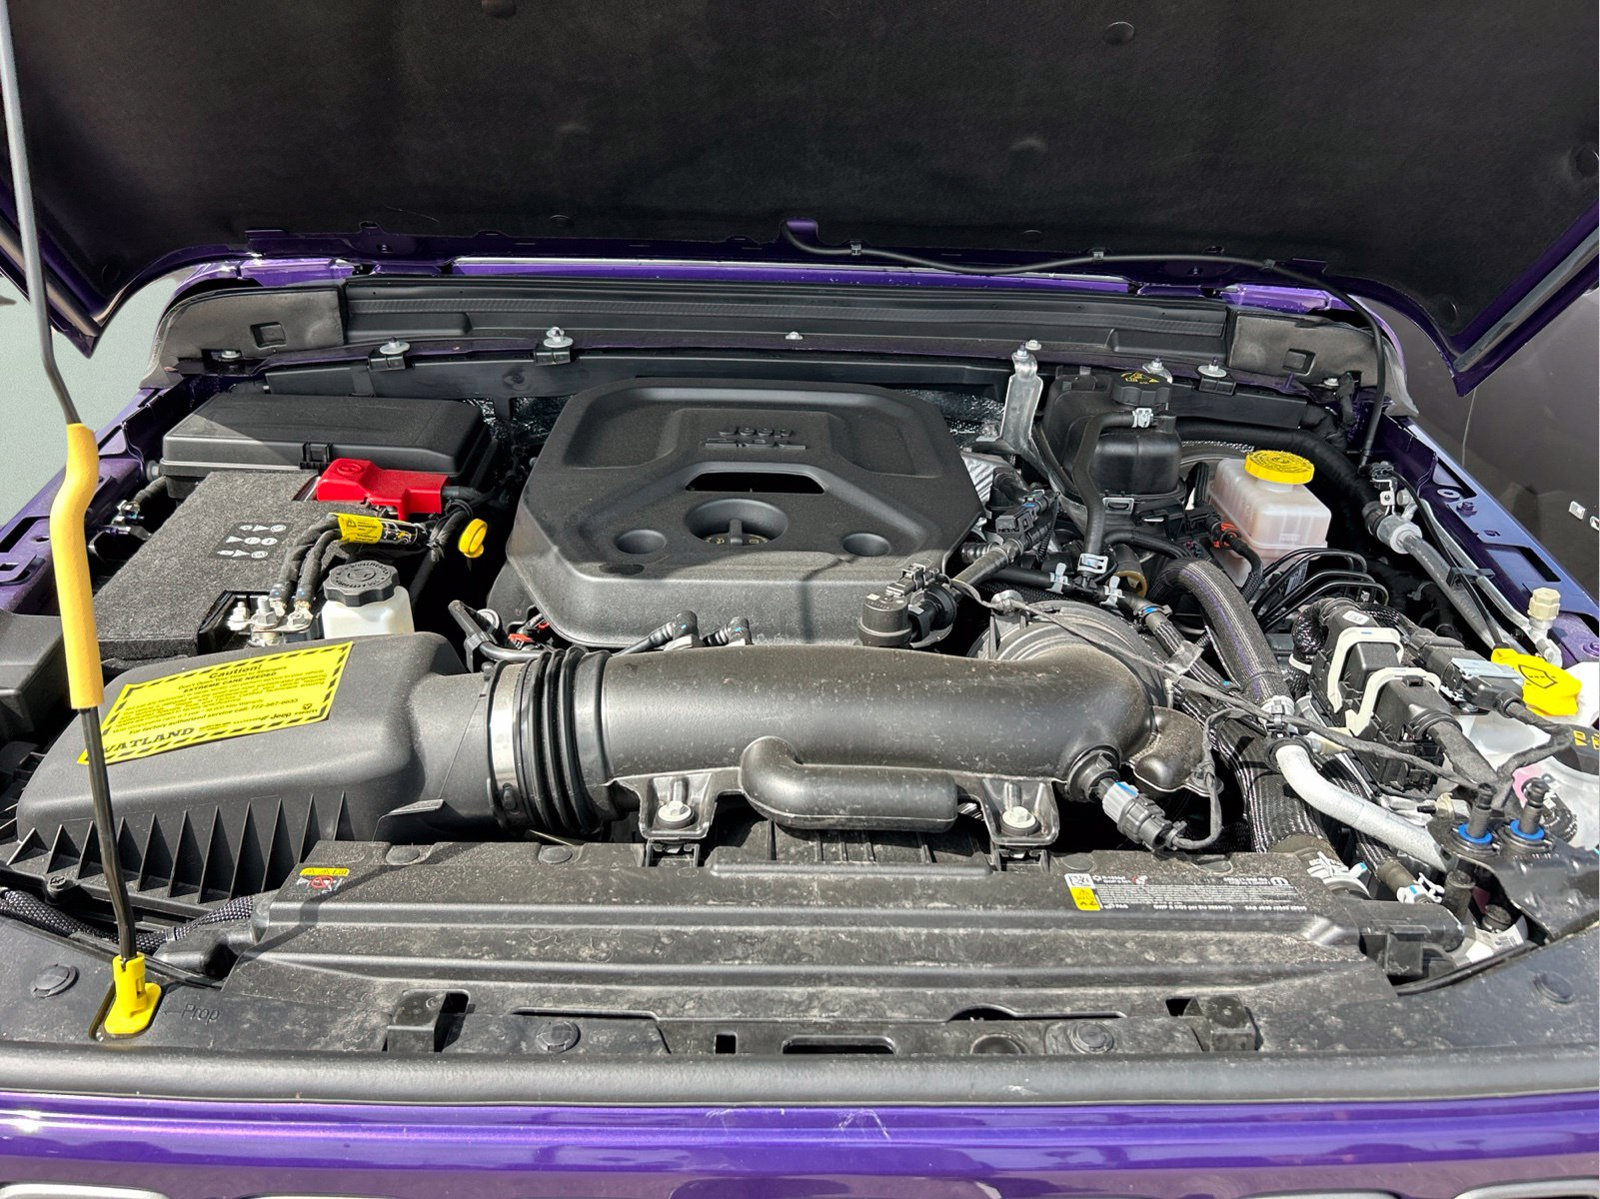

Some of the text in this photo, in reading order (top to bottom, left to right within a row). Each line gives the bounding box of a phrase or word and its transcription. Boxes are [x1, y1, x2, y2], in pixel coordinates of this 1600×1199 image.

[183, 682, 220, 693] EXTREME
[245, 672, 277, 680] NEEDED
[209, 665, 262, 679] Caution!
[105, 727, 195, 752] VATLAND
[270, 710, 292, 720] Jeep
[142, 723, 166, 732] factory
[207, 710, 233, 718] service
[182, 1003, 220, 1024] Prop
